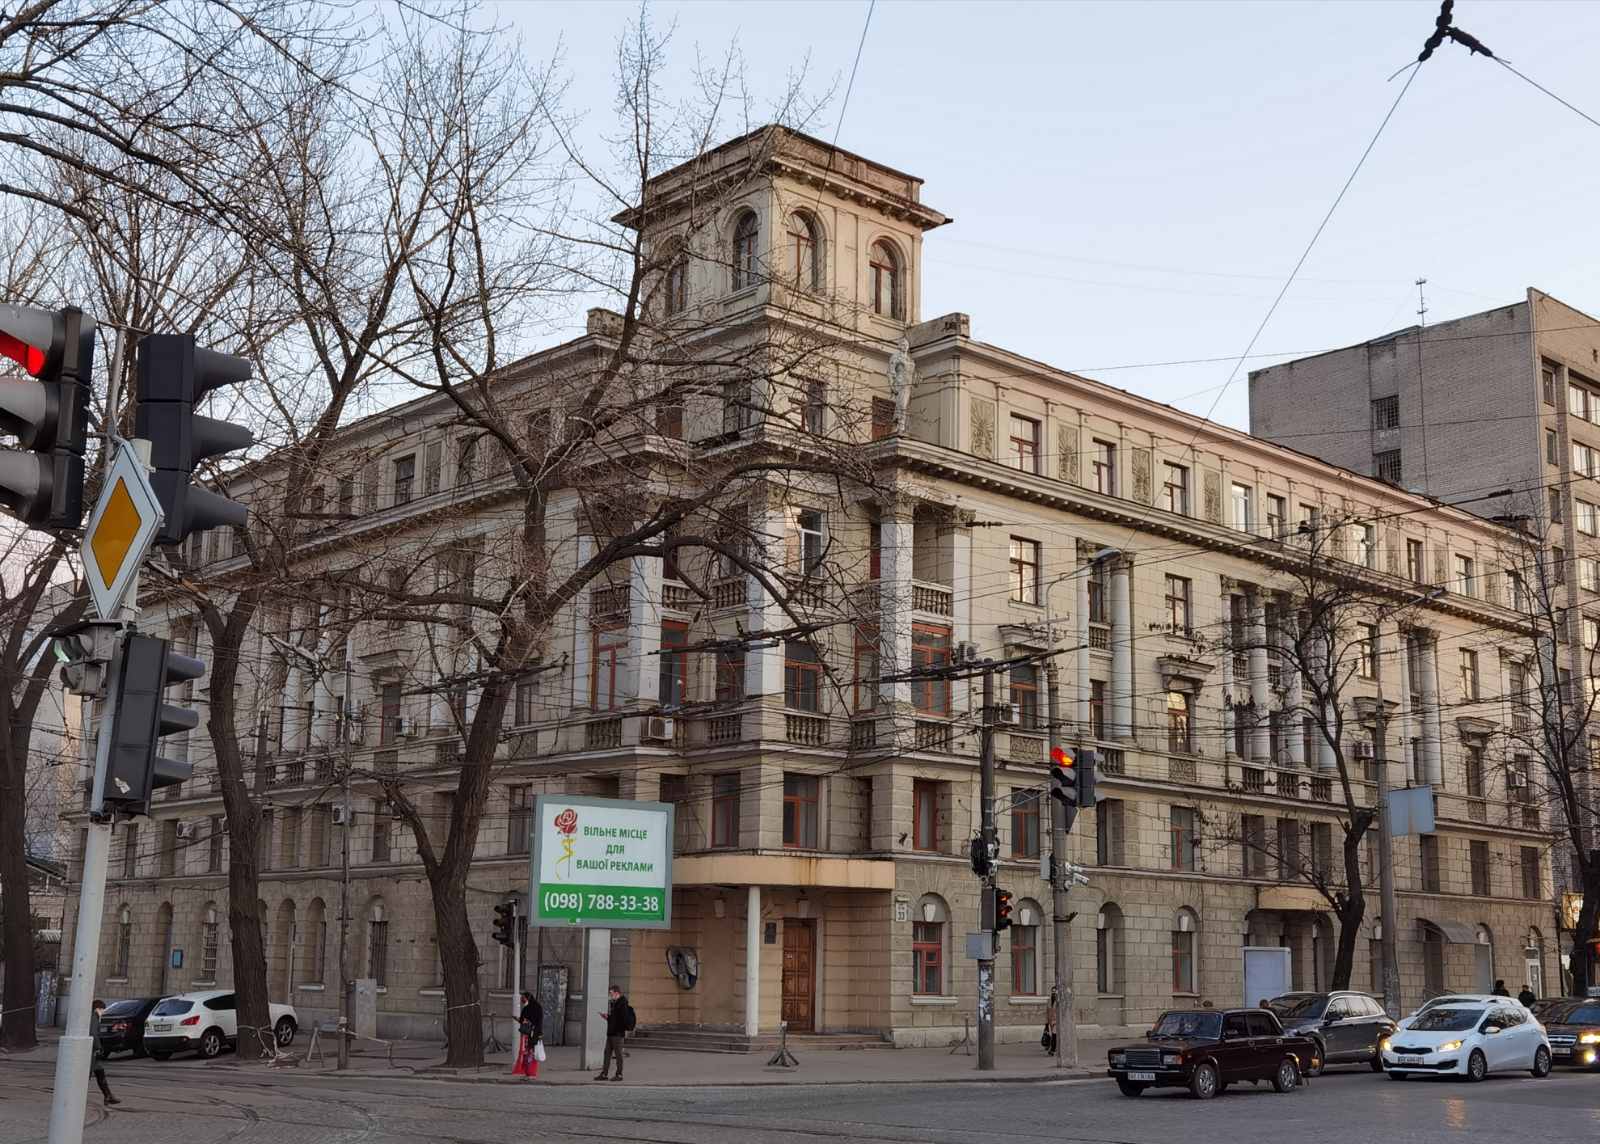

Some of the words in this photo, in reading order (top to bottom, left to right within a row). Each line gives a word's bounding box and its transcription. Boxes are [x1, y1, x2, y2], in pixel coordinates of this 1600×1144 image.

[584, 826, 617, 837] ВІЛЬНЕ
[619, 828, 648, 840] МІСЦЕ
[606, 844, 625, 856] ДЛЯ
[576, 859, 609, 870] ВАШОЇ
[610, 861, 654, 872] РЕКЛАМИ
[544, 892, 583, 912] (098)
[587, 894, 659, 911] 788-33-38
